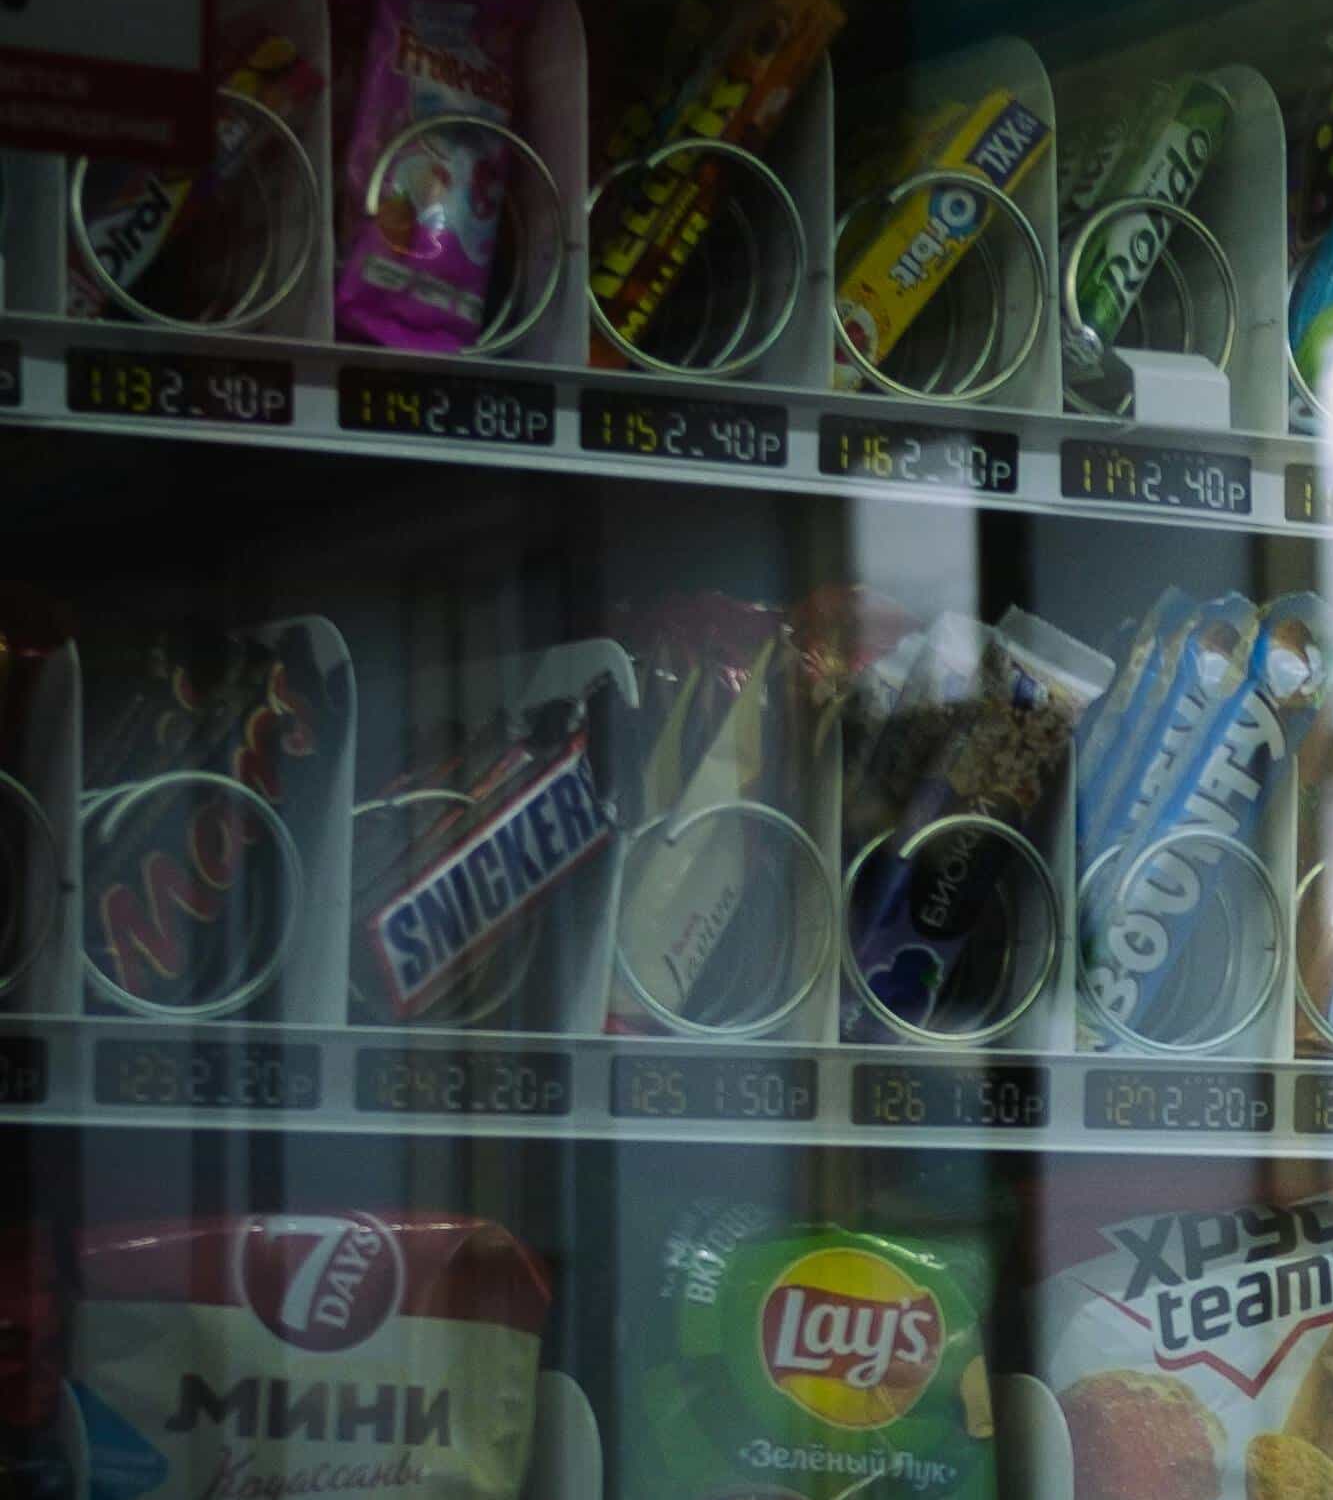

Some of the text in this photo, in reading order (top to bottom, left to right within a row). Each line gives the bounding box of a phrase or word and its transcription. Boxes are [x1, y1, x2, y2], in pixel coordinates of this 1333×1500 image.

[890, 188, 981, 287] Orbit
[264, 1213, 386, 1333] 7 DAYS
[773, 1286, 936, 1389] Lay's
[164, 1373, 451, 1447] МИНИ
